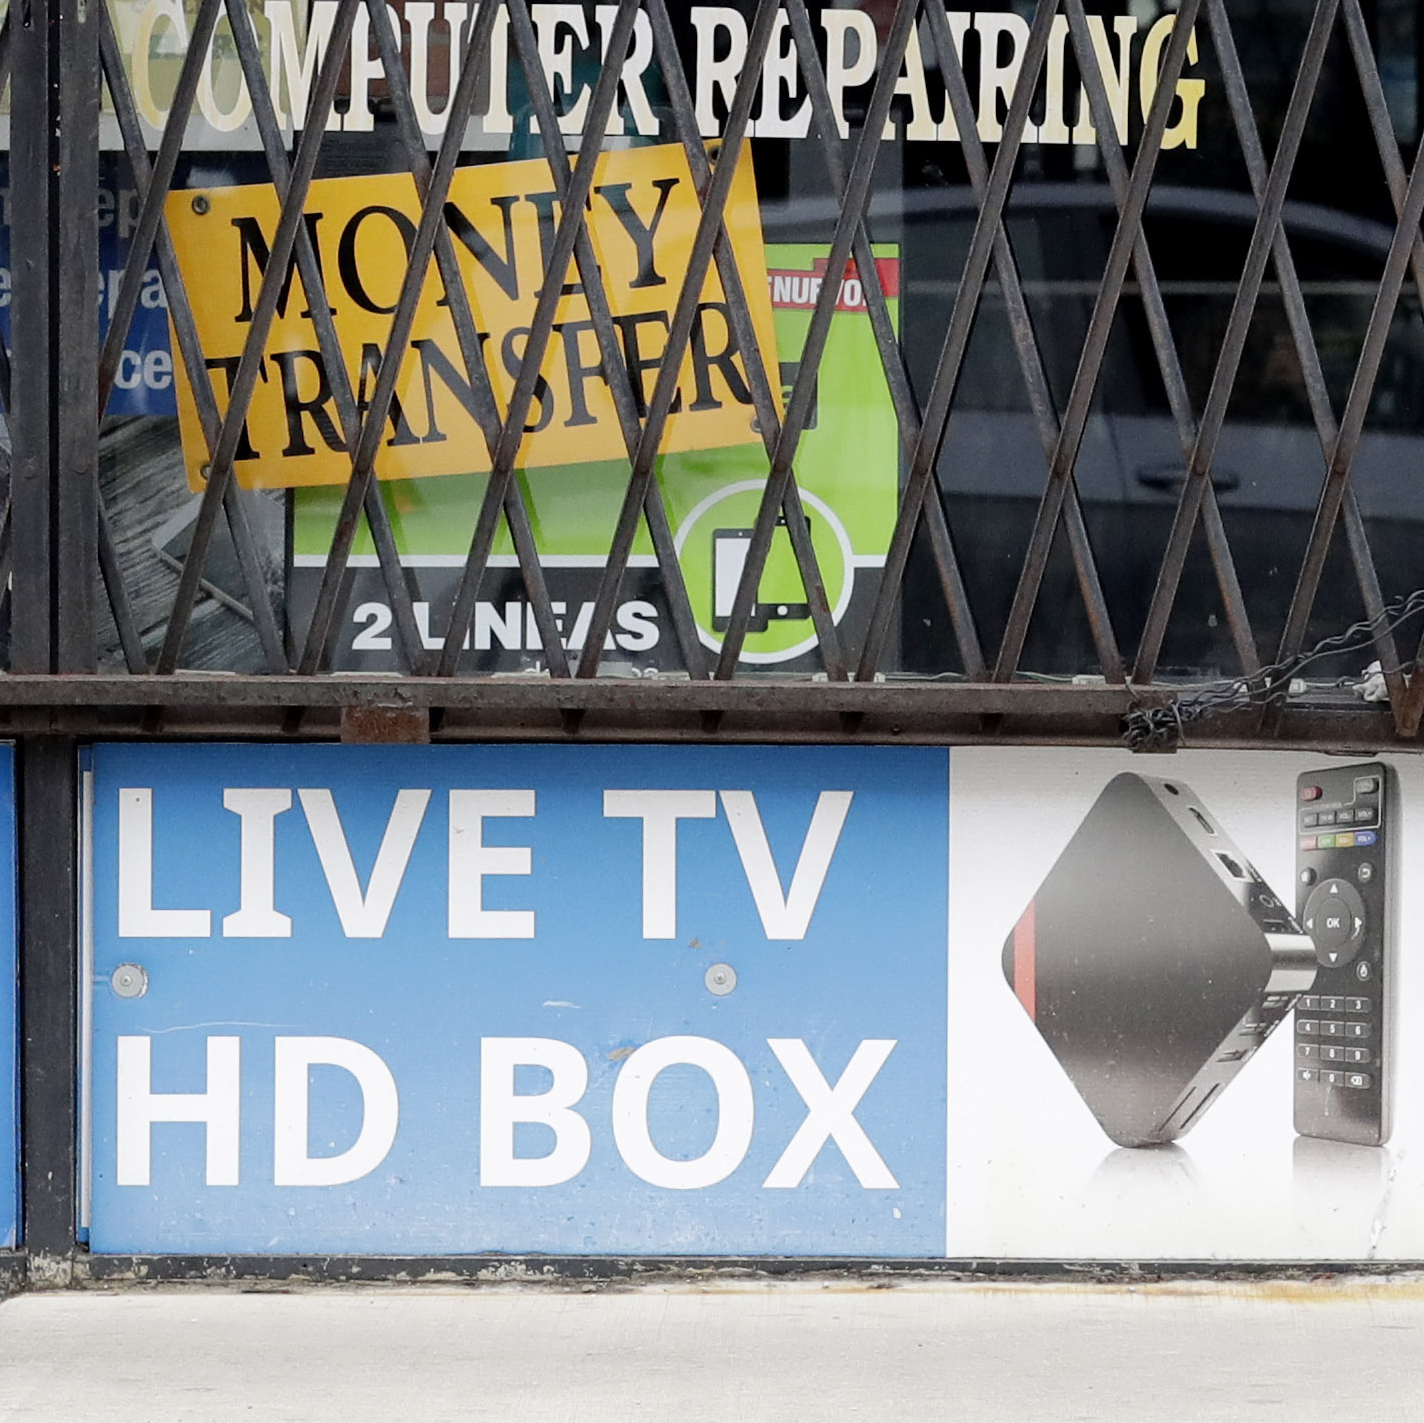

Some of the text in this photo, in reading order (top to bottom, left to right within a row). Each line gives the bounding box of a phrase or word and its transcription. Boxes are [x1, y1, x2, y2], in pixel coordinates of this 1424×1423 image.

[690, 5, 1207, 152] REPAIRING
[351, 601, 393, 651] 2
[117, 787, 536, 940] LIVE
[601, 789, 855, 941] TV
[1326, 917, 1341, 929] OK
[115, 1034, 902, 1191] HD BOX
